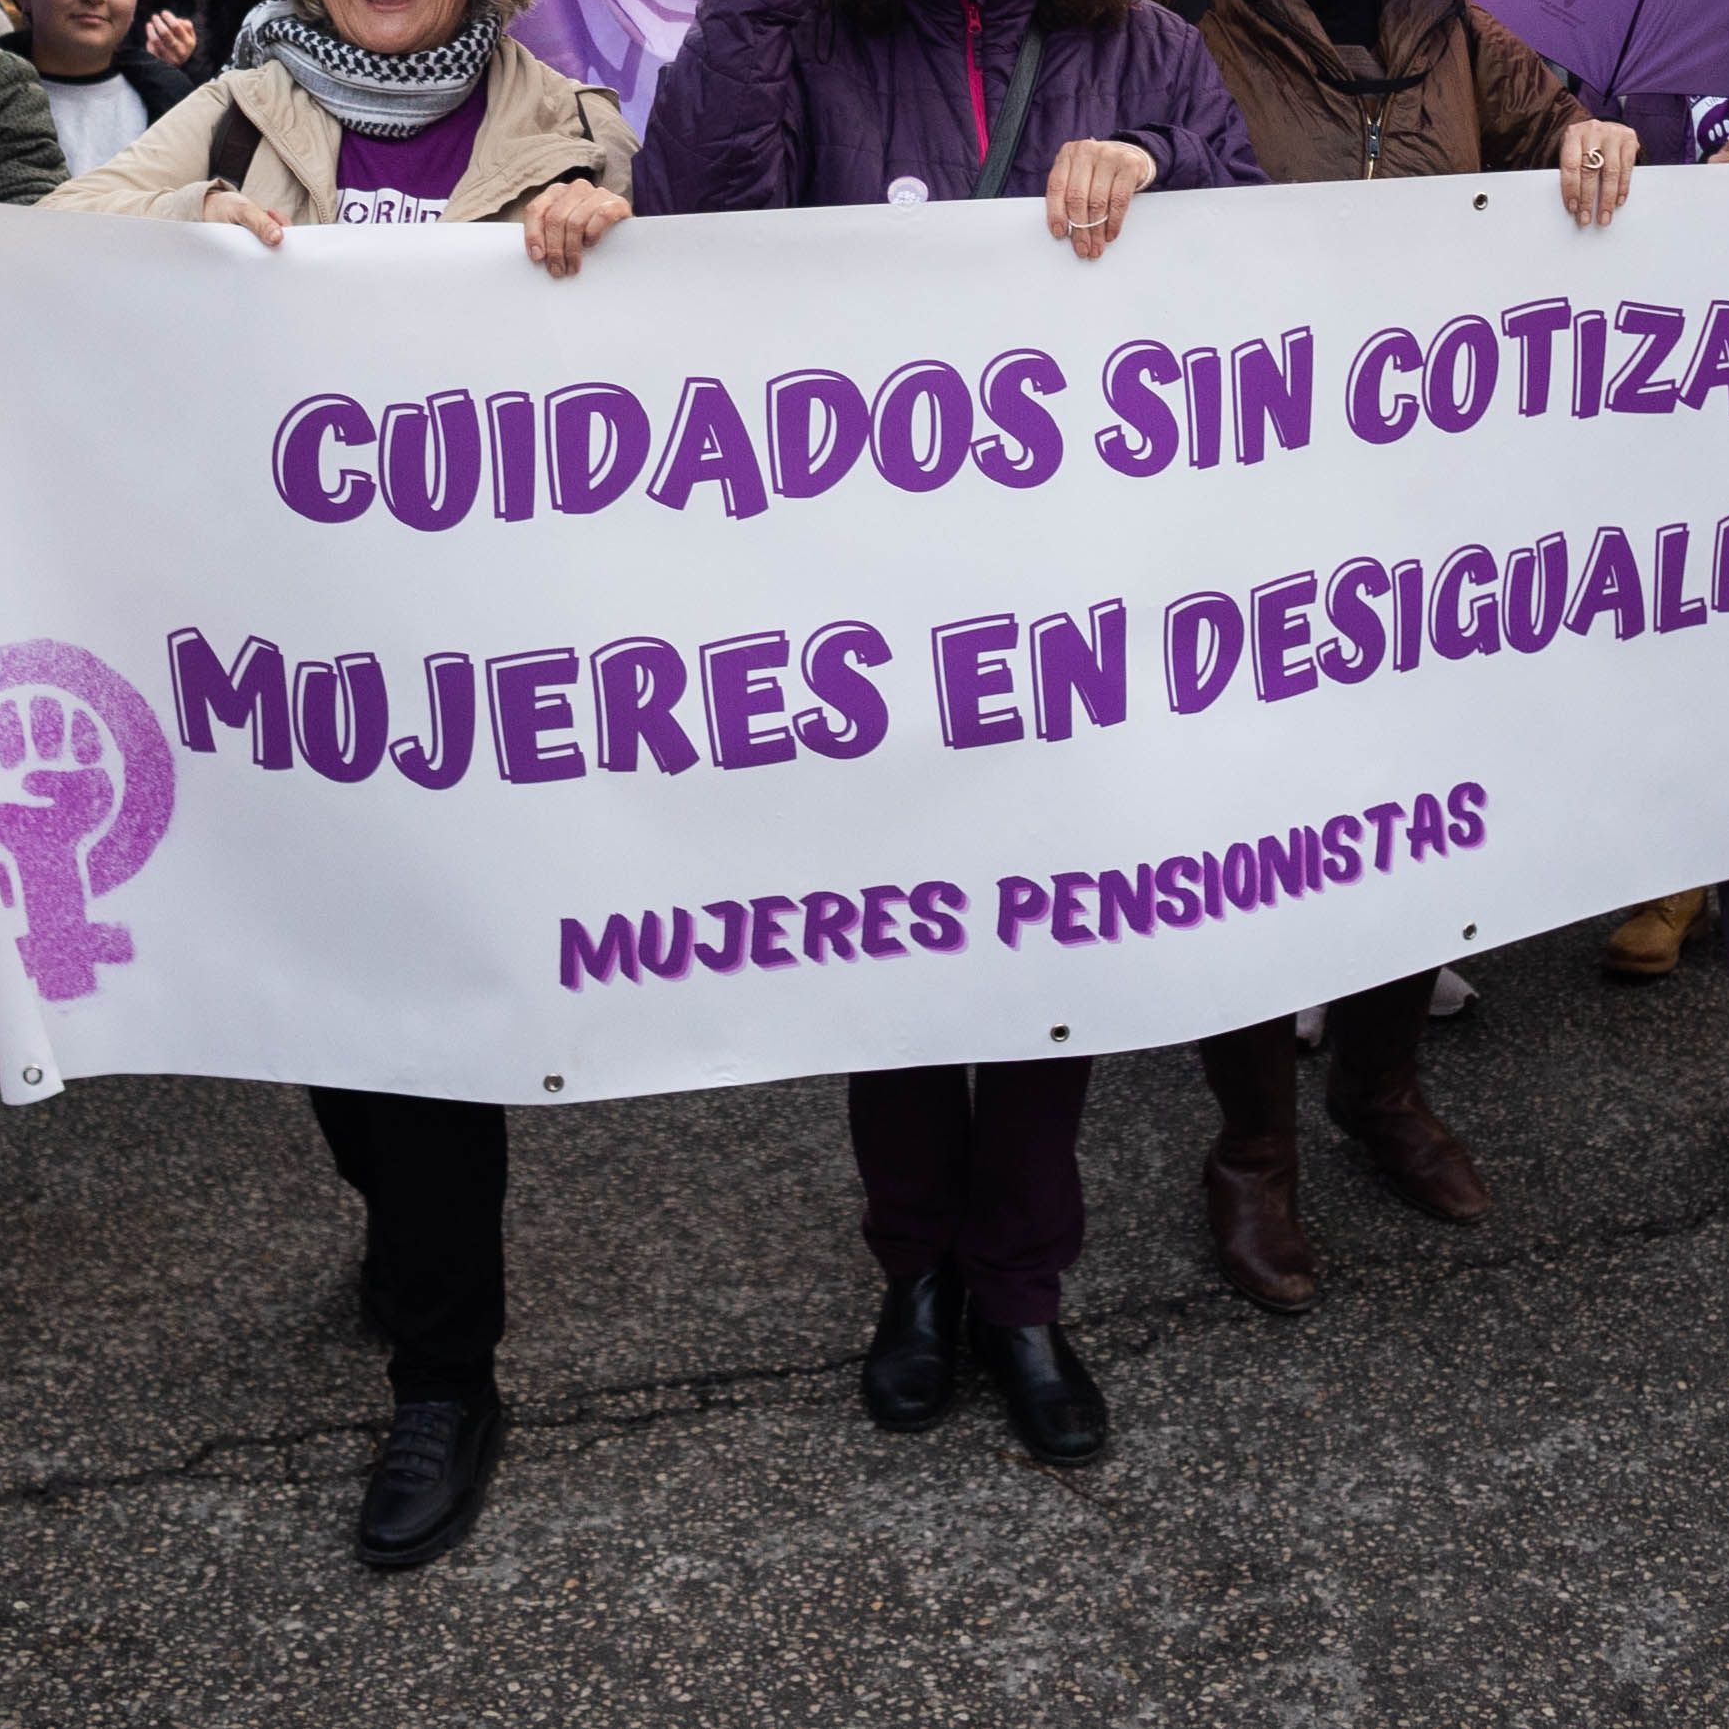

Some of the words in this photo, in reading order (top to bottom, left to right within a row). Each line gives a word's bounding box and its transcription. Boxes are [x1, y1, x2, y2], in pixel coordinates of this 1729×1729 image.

[272, 349, 1066, 531] CUIDADOS
[1095, 326, 1313, 477] SIN
[168, 621, 892, 790] MUJERES
[932, 598, 1126, 750] EN
[560, 881, 967, 991] MUJERES
[997, 782, 1487, 948] PENSIONISTAS
